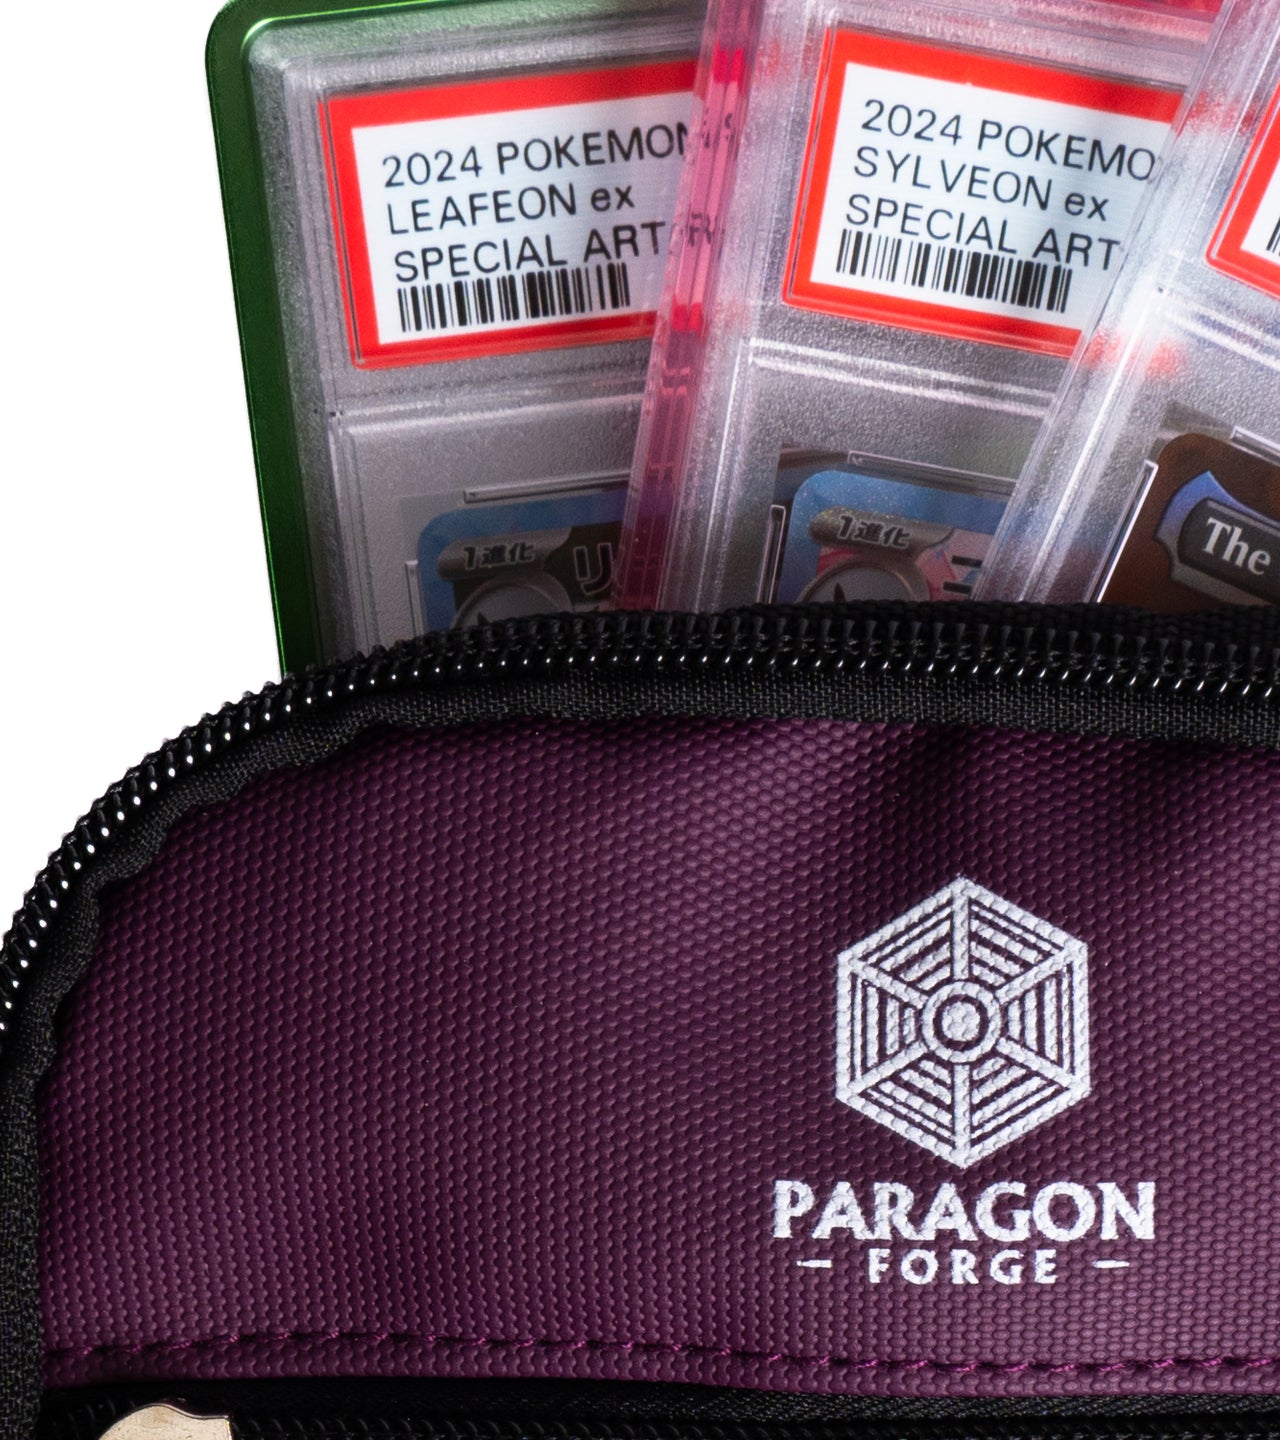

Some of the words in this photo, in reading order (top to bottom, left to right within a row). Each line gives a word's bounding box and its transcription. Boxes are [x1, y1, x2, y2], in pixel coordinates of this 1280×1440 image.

[382, 147, 483, 188] 2024
[861, 99, 963, 146] 2024
[977, 119, 1158, 182] POKEMO
[387, 183, 577, 235] LEAFEON
[590, 185, 635, 213] ex
[854, 146, 1053, 211] SYLVEON
[1064, 191, 1108, 221] ex
[395, 234, 568, 283] SPECIAL
[584, 221, 666, 263] ART
[846, 194, 1017, 255] SPECIAL
[1032, 228, 1122, 271] ART
[1202, 517, 1271, 575] The
[772, 1179, 1156, 1241] PARAGON
[867, 1248, 1059, 1285] FORGE
